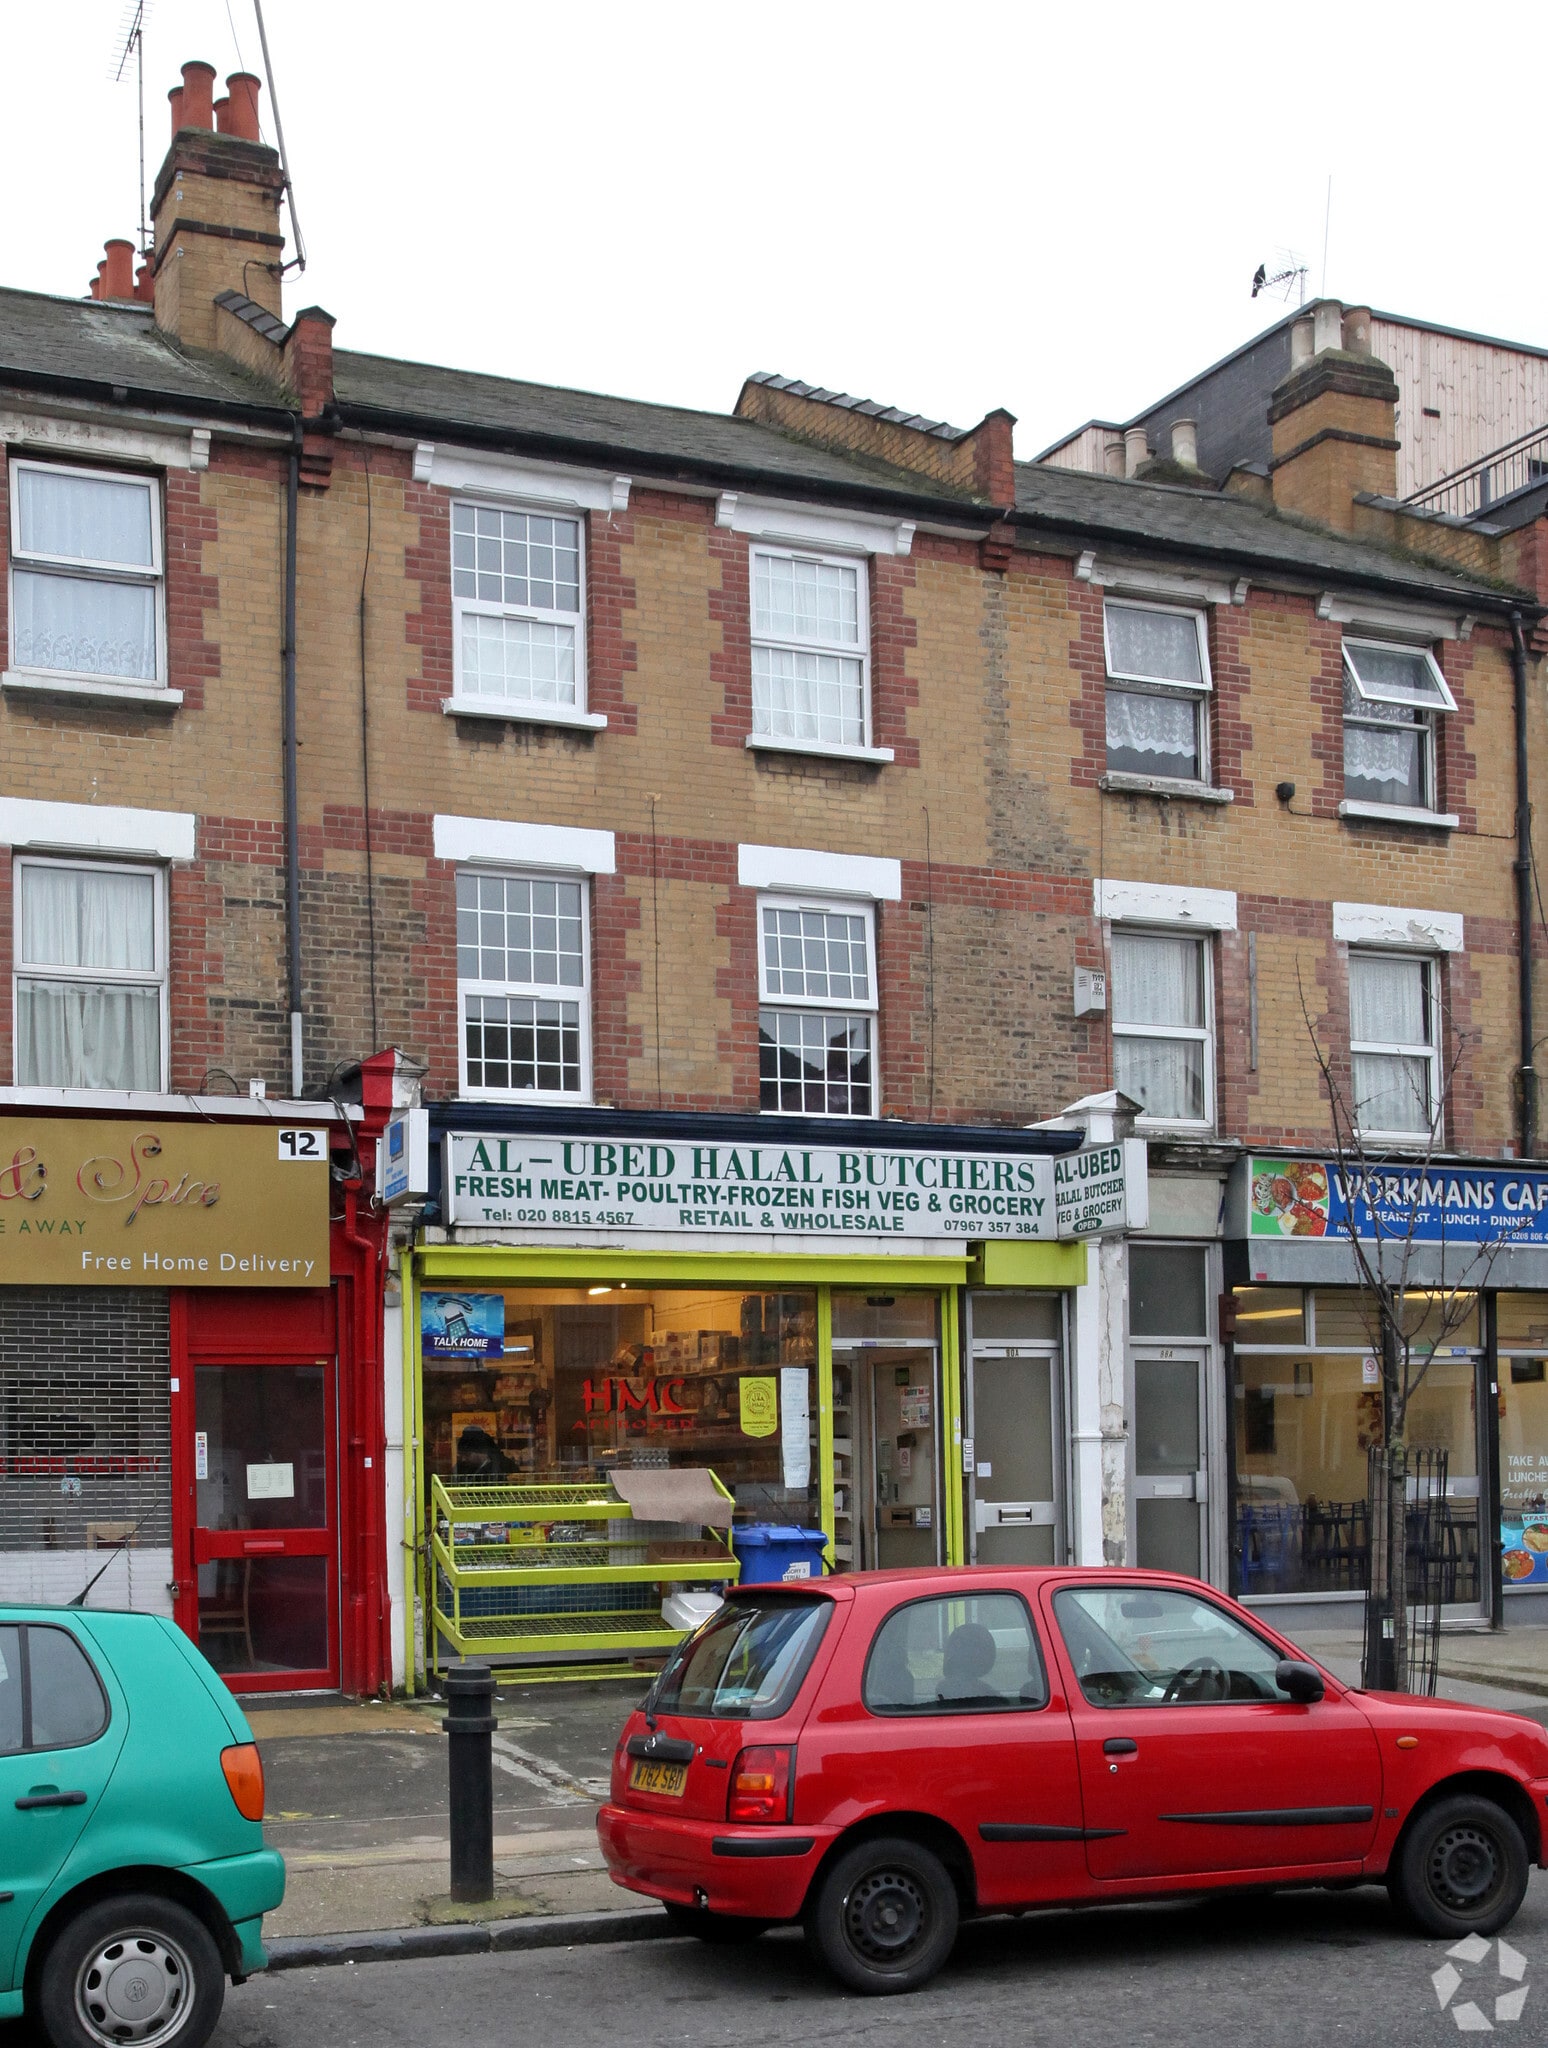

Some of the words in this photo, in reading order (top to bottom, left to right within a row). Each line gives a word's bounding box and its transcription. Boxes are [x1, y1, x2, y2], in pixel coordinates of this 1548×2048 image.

[280, 1131, 320, 1156] 92
[691, 1147, 823, 1183] HALAL
[836, 1153, 1035, 1193] BUTCHERS
[1054, 1148, 1121, 1185] AL-UBED
[77, 1132, 220, 1227] Spice
[1084, 1178, 1125, 1200] BUTCHER
[455, 1175, 532, 1198] FRESH
[822, 1188, 870, 1209] FISH
[877, 1191, 920, 1212] VEG
[927, 1193, 942, 1213] &
[949, 1194, 1046, 1216] GROCERY
[1333, 1174, 1495, 1210] WORKMANS
[482, 1208, 512, 1221] Tel:
[517, 1209, 547, 1222] 020
[552, 1210, 591, 1223] 8815
[596, 1211, 634, 1225] 4567
[679, 1209, 753, 1227] RETAIL
[760, 1212, 774, 1228] &
[781, 1213, 905, 1231] WHOLESALE
[1074, 1208, 1080, 1220] &
[1082, 1198, 1123, 1219] GROCERY
[19, 1219, 87, 1235] AWAY
[943, 1219, 983, 1232] 07967
[988, 1221, 1011, 1233] 357
[1016, 1223, 1039, 1234] 384
[1078, 1220, 1097, 1231] OPEN
[82, 1251, 132, 1270] Free
[143, 1252, 209, 1272] Home
[220, 1253, 315, 1278] Delivery
[433, 1337, 458, 1346] TALK
[460, 1338, 488, 1348] HOME
[582, 1378, 685, 1413] HMC
[572, 1419, 693, 1430] APPROVED
[1508, 1455, 1533, 1466] TAKE
